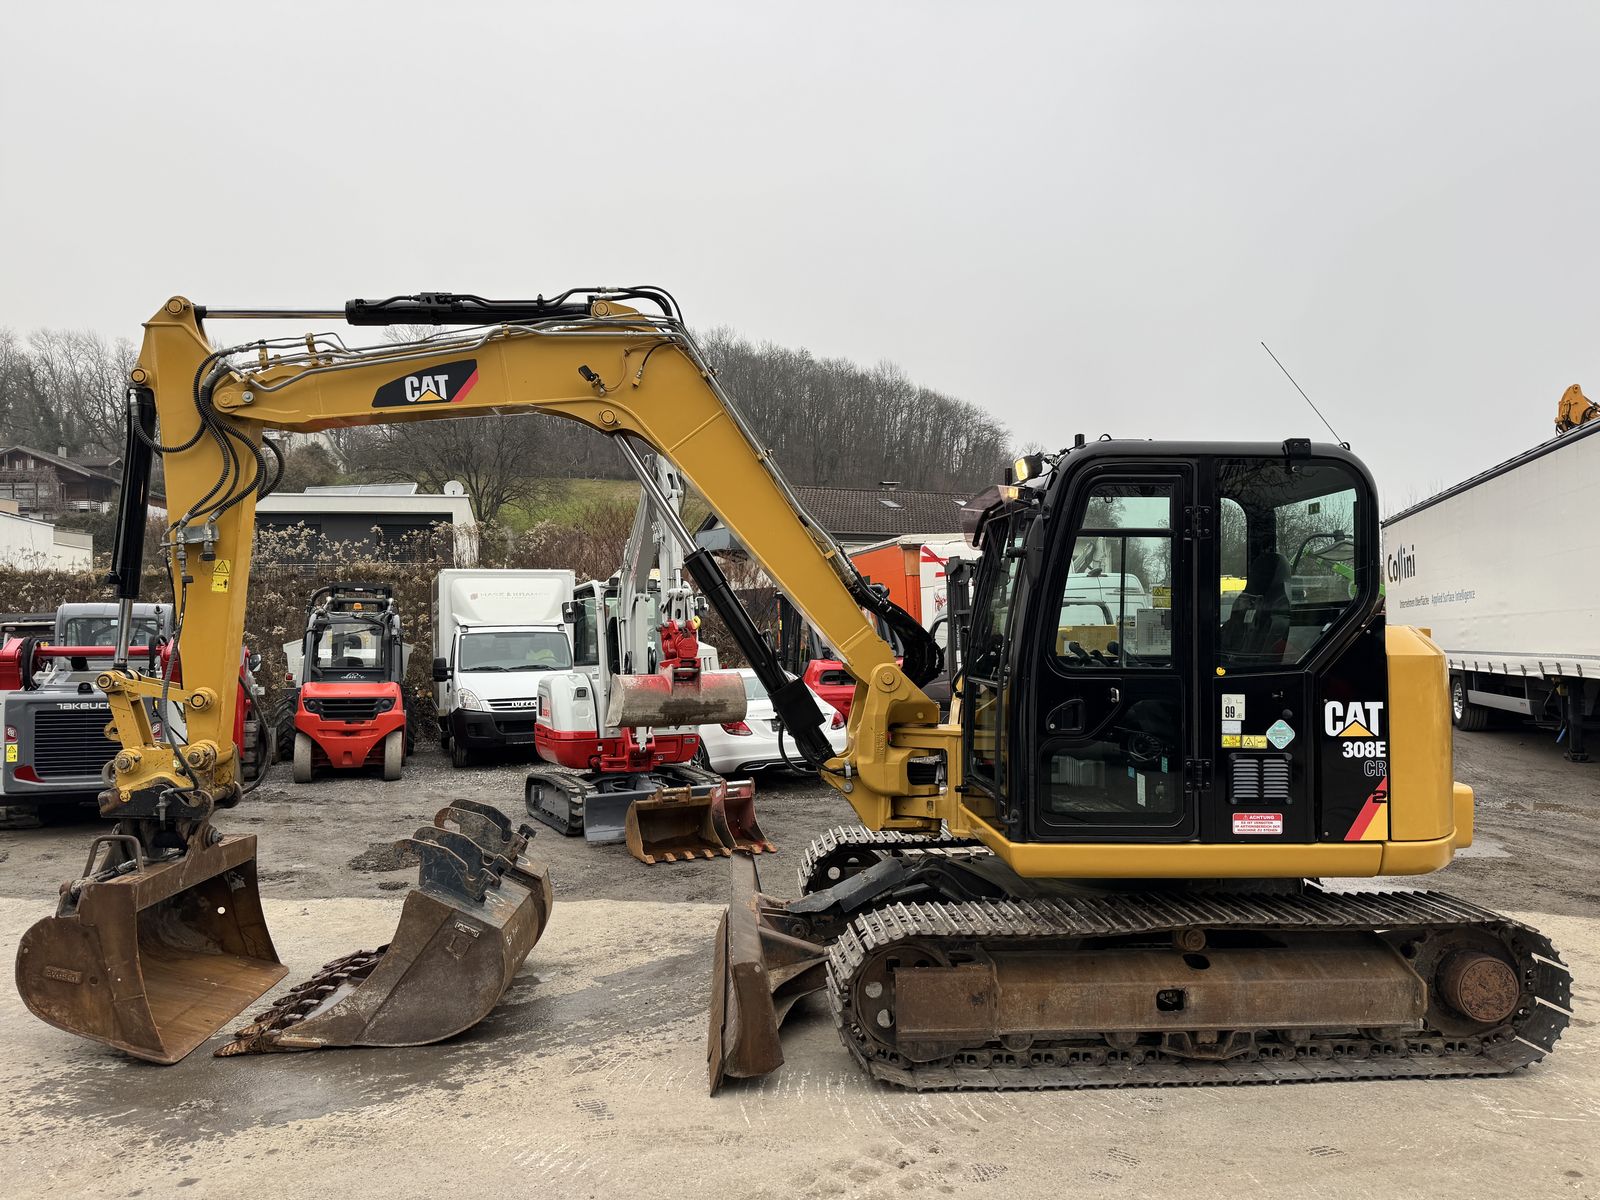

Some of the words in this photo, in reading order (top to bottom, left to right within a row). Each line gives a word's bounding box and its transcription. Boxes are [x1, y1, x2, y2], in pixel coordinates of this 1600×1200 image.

[404, 374, 449, 402] CAT
[1388, 544, 1416, 586] Collini
[1225, 706, 1236, 718] 99
[1324, 701, 1384, 737] CAT
[1342, 741, 1387, 758] 308E
[1363, 760, 1388, 777] CR
[1372, 790, 1388, 804] 2
